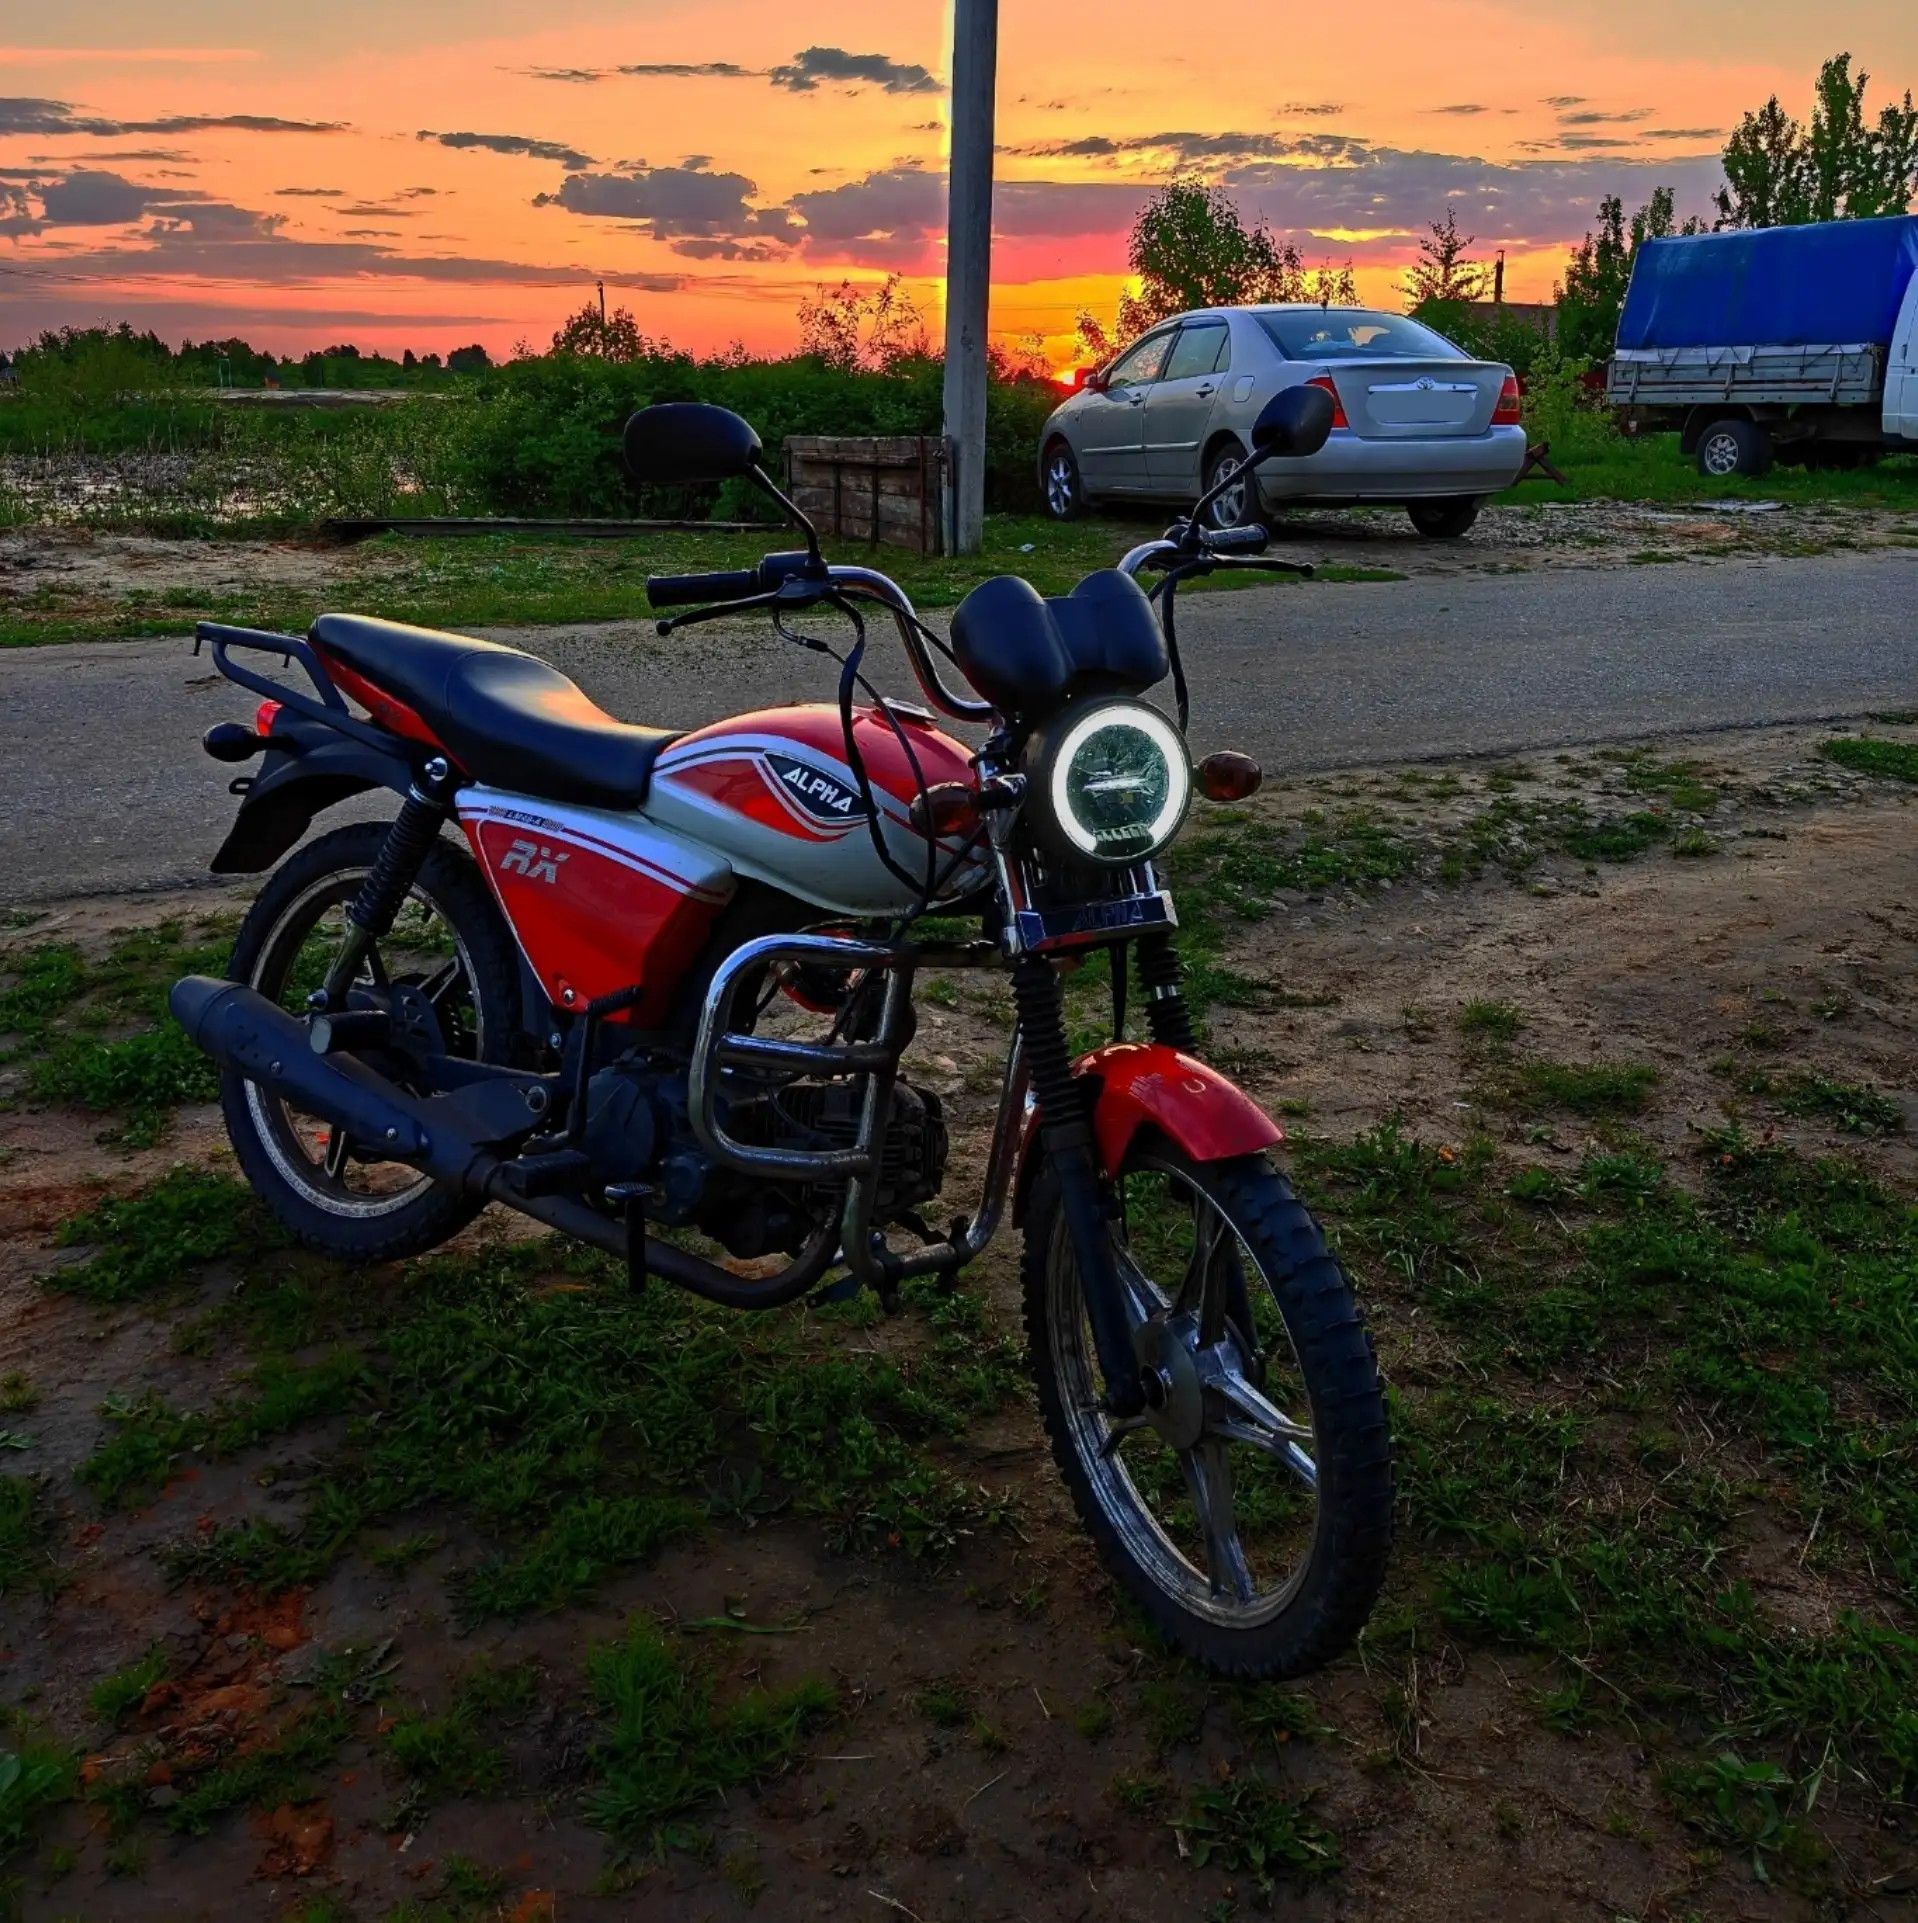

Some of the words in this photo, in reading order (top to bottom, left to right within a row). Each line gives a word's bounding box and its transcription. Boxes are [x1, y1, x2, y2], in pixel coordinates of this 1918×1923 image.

[782, 767, 853, 813] ALPHA
[500, 838, 571, 884] RX
[1072, 901, 1145, 931] ALPHA
